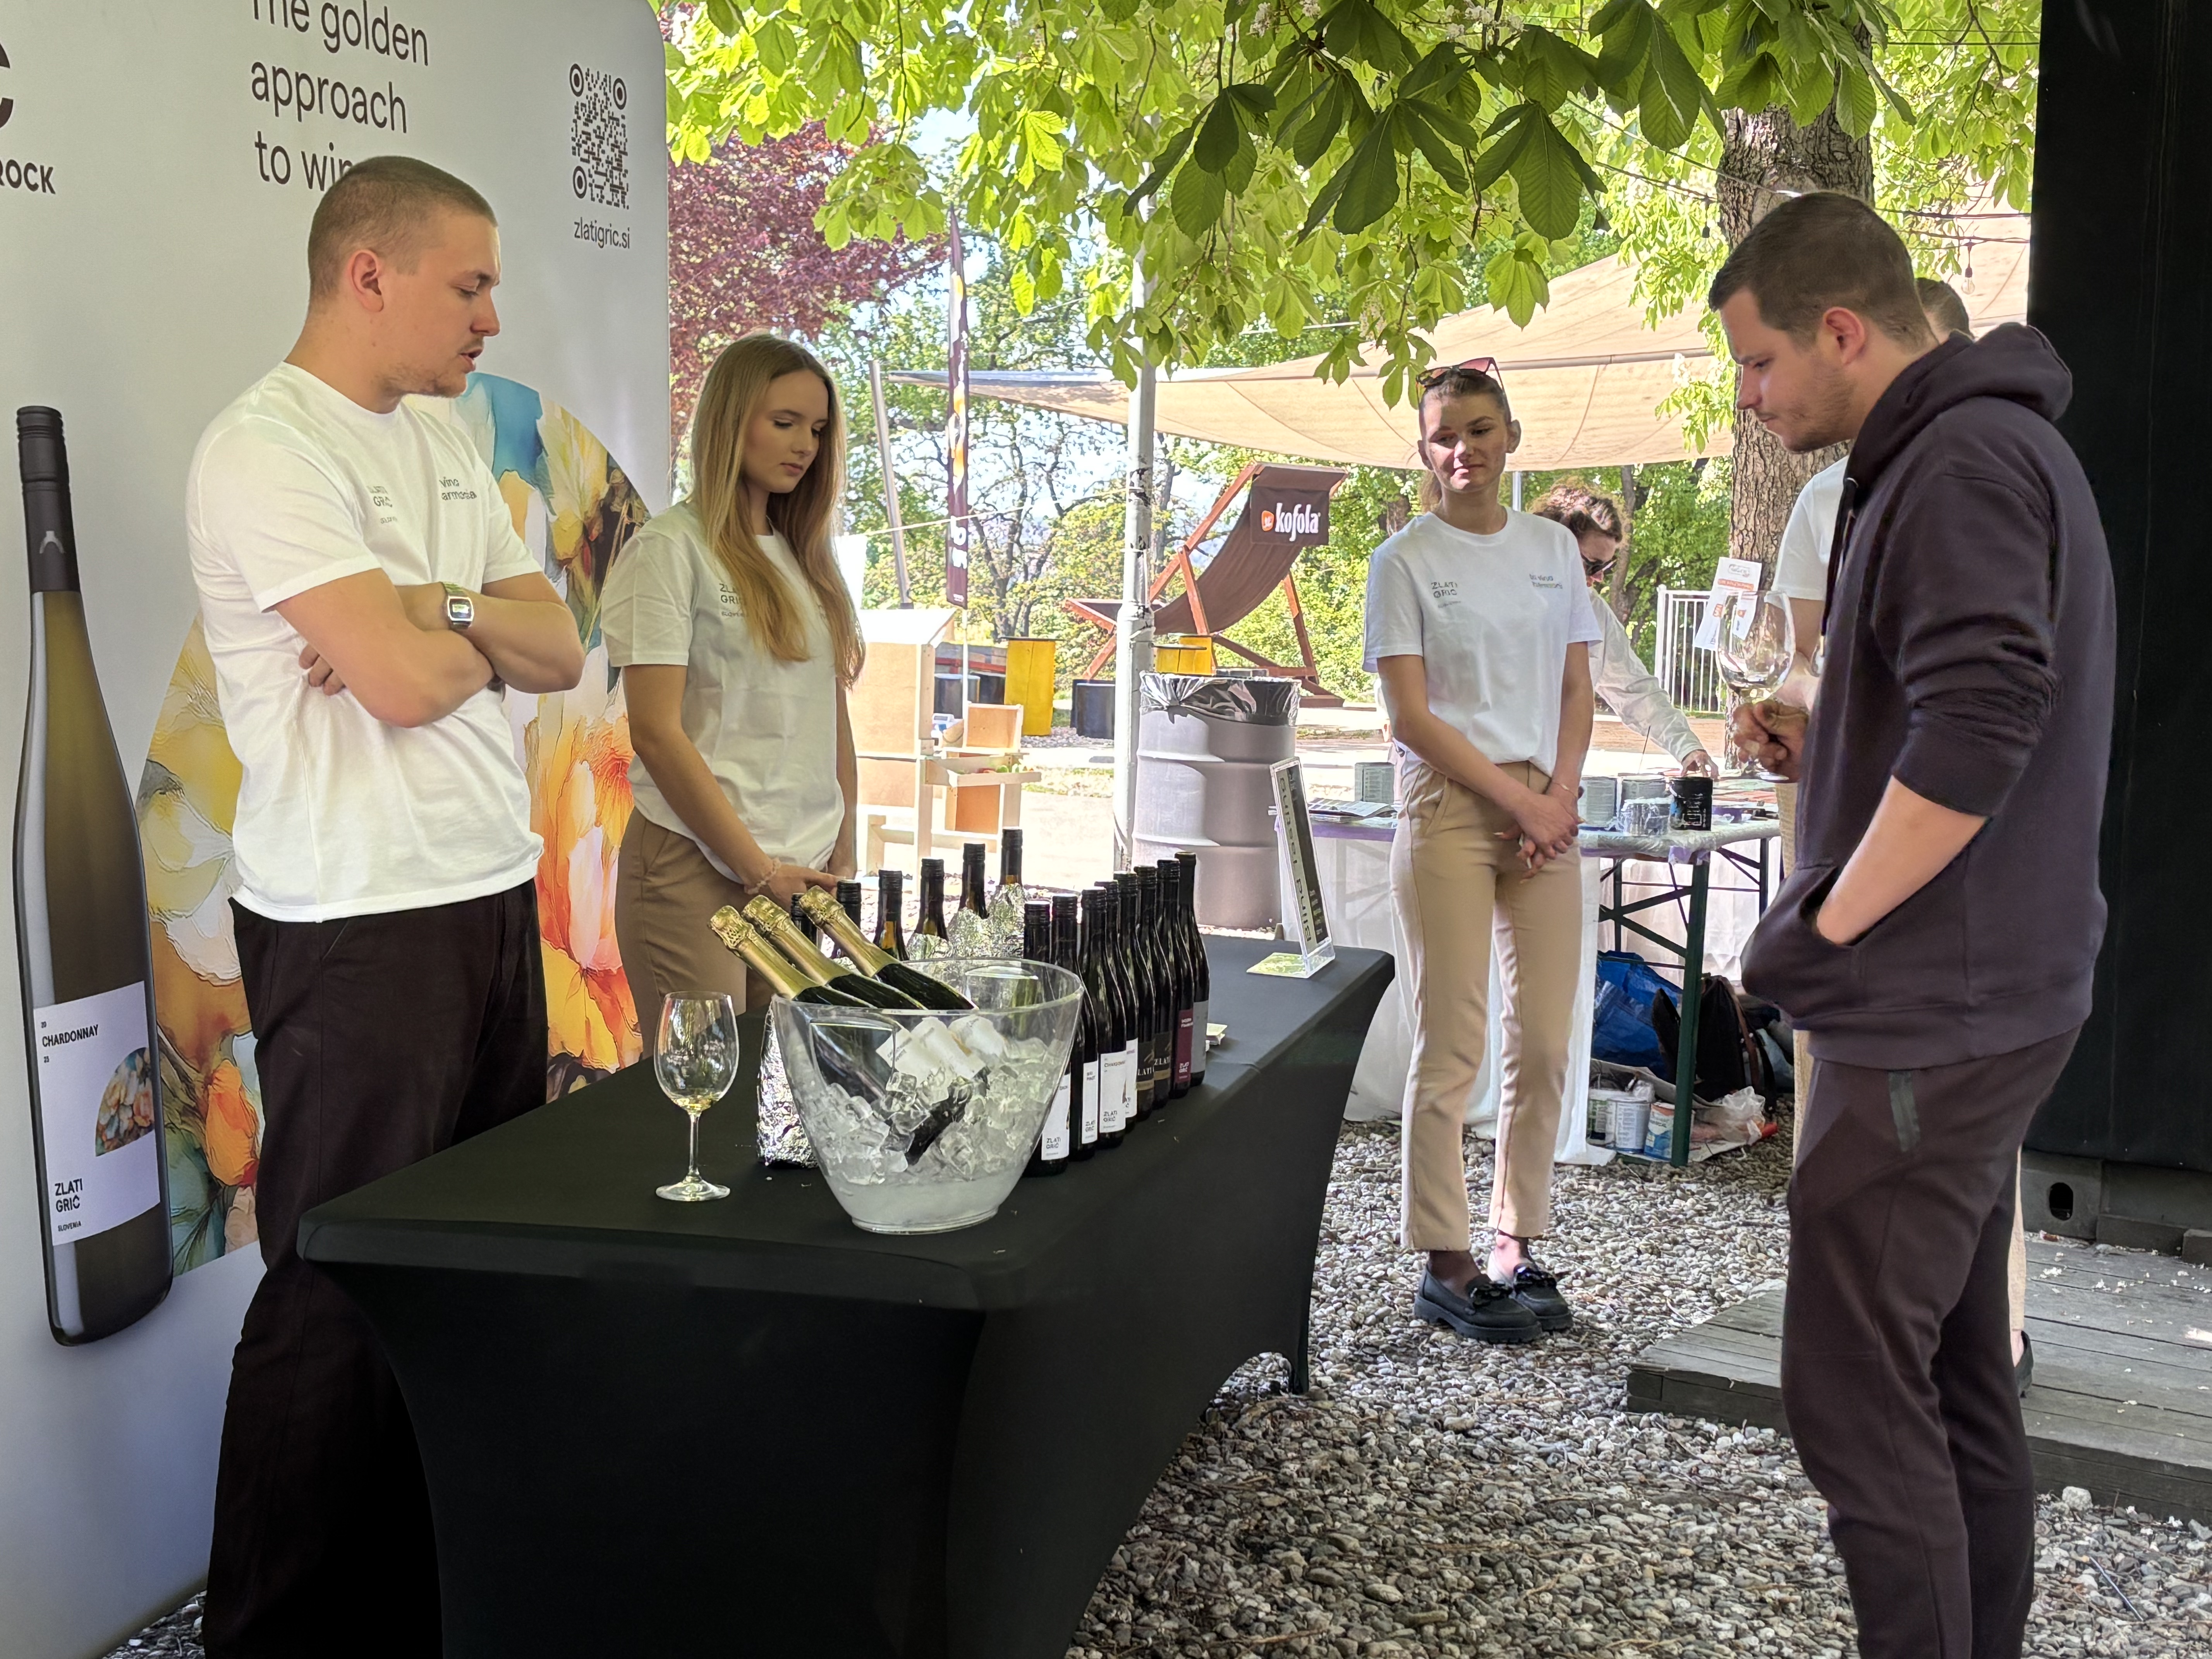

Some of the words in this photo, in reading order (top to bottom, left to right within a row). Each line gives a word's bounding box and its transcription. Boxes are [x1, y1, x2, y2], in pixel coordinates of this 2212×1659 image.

[321, 2, 428, 66] golden
[251, 61, 407, 134] approach
[254, 131, 291, 185] to
[574, 216, 630, 249] zlatigric.si
[1275, 503, 1319, 542] kofola
[721, 595, 740, 604] GRI
[42, 1024, 98, 1047] CHARDONNAY
[1138, 1067, 1152, 1075] LATI
[55, 1178, 82, 1196] ZLATI
